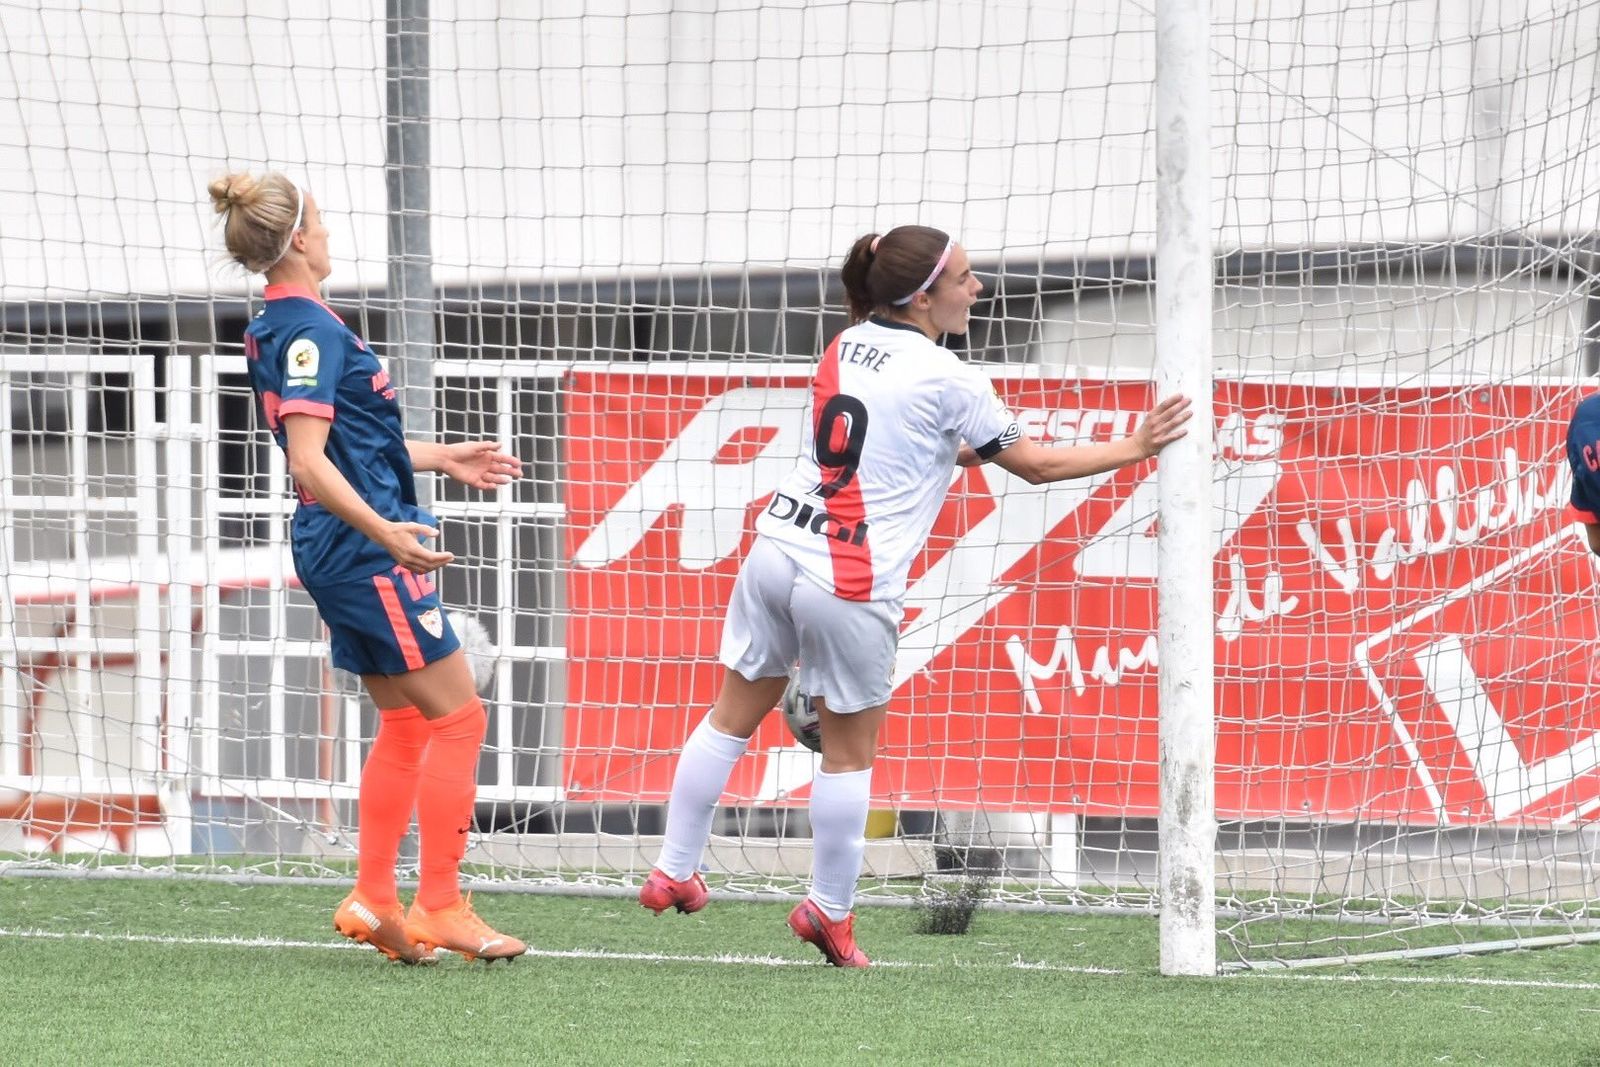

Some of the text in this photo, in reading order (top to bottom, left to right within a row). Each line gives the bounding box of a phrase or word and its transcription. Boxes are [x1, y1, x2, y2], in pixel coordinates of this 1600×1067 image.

[839, 341, 891, 373] TERE
[806, 394, 869, 500] 9
[768, 492, 869, 547] DIGI
